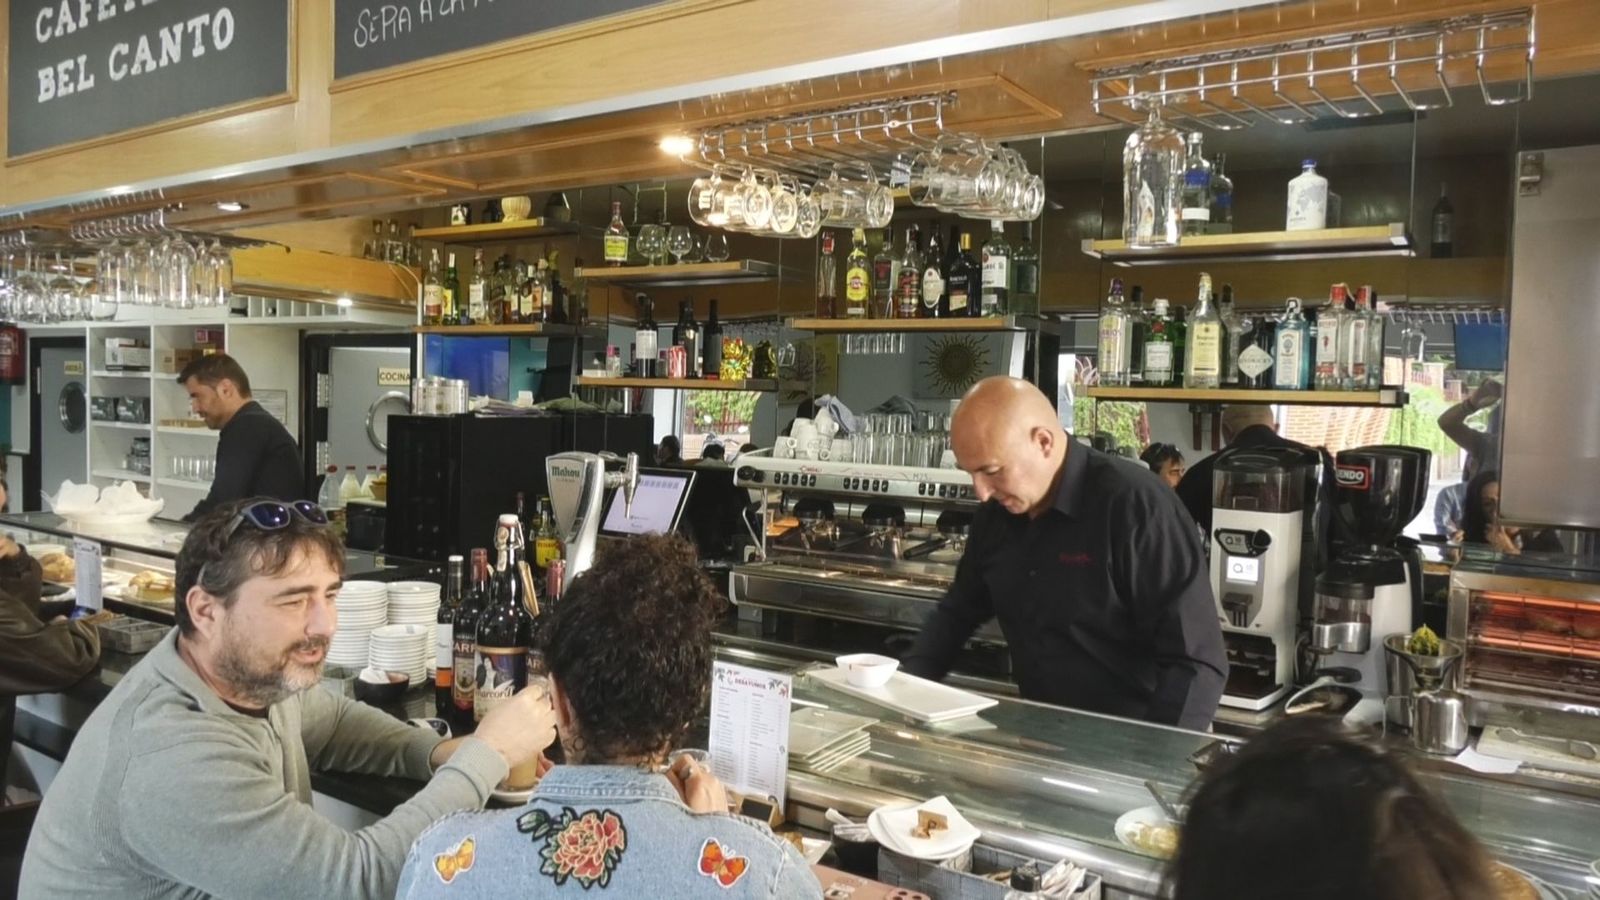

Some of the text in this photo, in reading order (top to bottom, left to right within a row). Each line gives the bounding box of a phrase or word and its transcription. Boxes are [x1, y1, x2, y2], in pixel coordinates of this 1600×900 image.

[419, 0, 433, 24] A
[38, 7, 235, 103] BEL CANTO
[379, 371, 411, 381] COCINA
[551, 466, 580, 478] Mahou
[1336, 469, 1365, 481] ENDO
